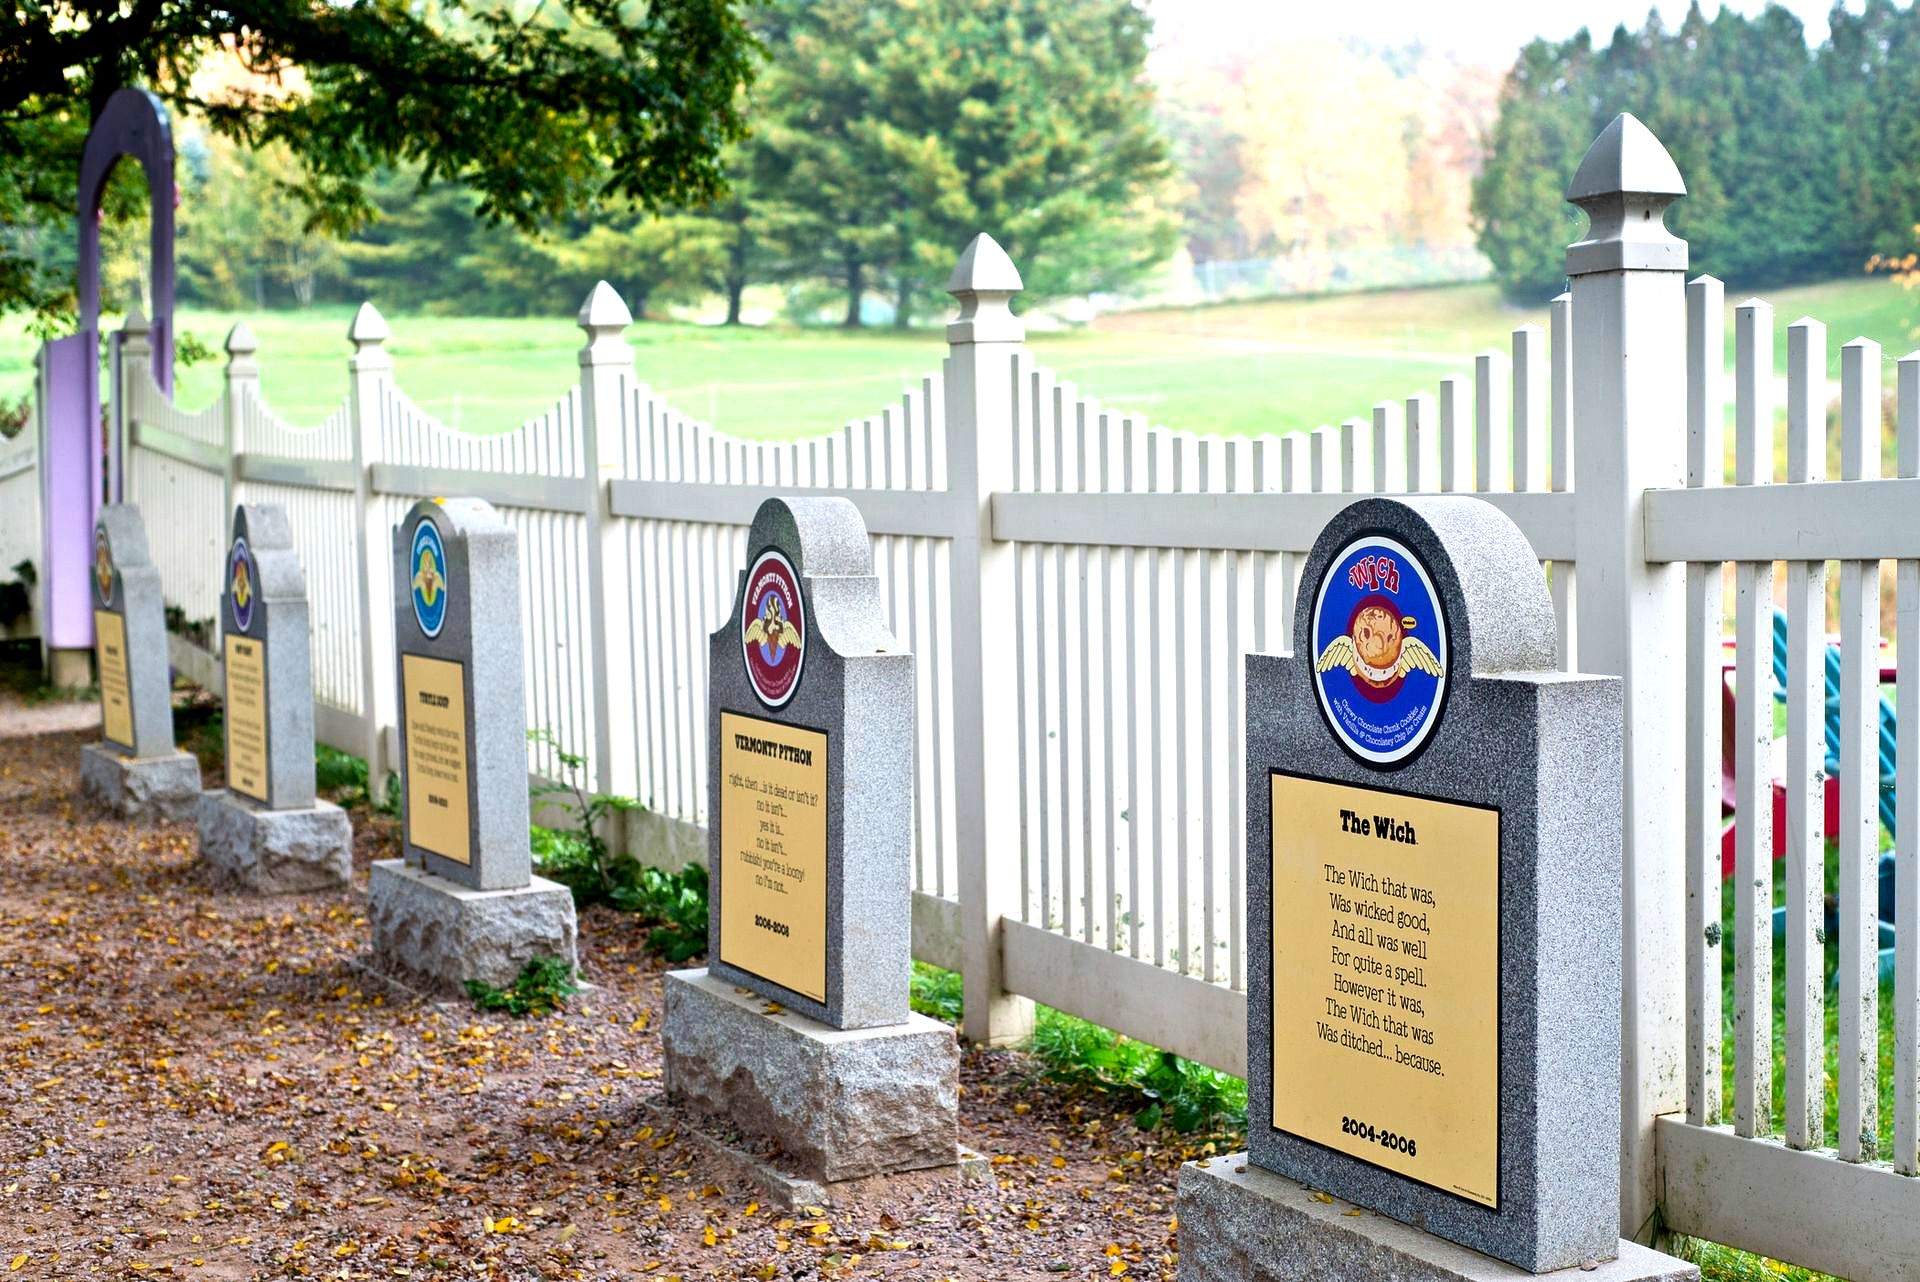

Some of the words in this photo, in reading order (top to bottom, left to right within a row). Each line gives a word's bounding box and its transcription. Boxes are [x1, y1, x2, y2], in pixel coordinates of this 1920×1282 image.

[735, 733, 778, 758] VERMONTY
[779, 743, 812, 767] PYTHON
[1340, 809, 1370, 836] The
[1373, 815, 1416, 845] Wich
[1324, 864, 1345, 884] The
[1348, 870, 1379, 893] Wich
[1381, 877, 1407, 900] that
[1411, 886, 1436, 909] was,
[1329, 892, 1351, 913] Was
[1354, 899, 1394, 924] wicked
[1397, 911, 1430, 936] good,
[1331, 919, 1355, 941] And
[1358, 926, 1374, 946] all
[1376, 934, 1398, 952] was
[1402, 940, 1427, 960] well
[1331, 945, 1350, 967] For
[1353, 955, 1382, 974] quite
[1385, 963, 1392, 979] a
[1395, 966, 1427, 987] spell.
[1334, 973, 1384, 1003] However
[1387, 988, 1396, 1007] it
[1400, 995, 1425, 1018] was,
[1325, 997, 1347, 1019] The
[1350, 1004, 1380, 1030] Wich
[1383, 1014, 1408, 1038] that
[1411, 1025, 1434, 1045] was
[1316, 1021, 1338, 1044] Was
[1340, 1029, 1392, 1061] ditched...
[1395, 1044, 1445, 1077] because.
[1341, 1116, 1417, 1157] 2004-2006
